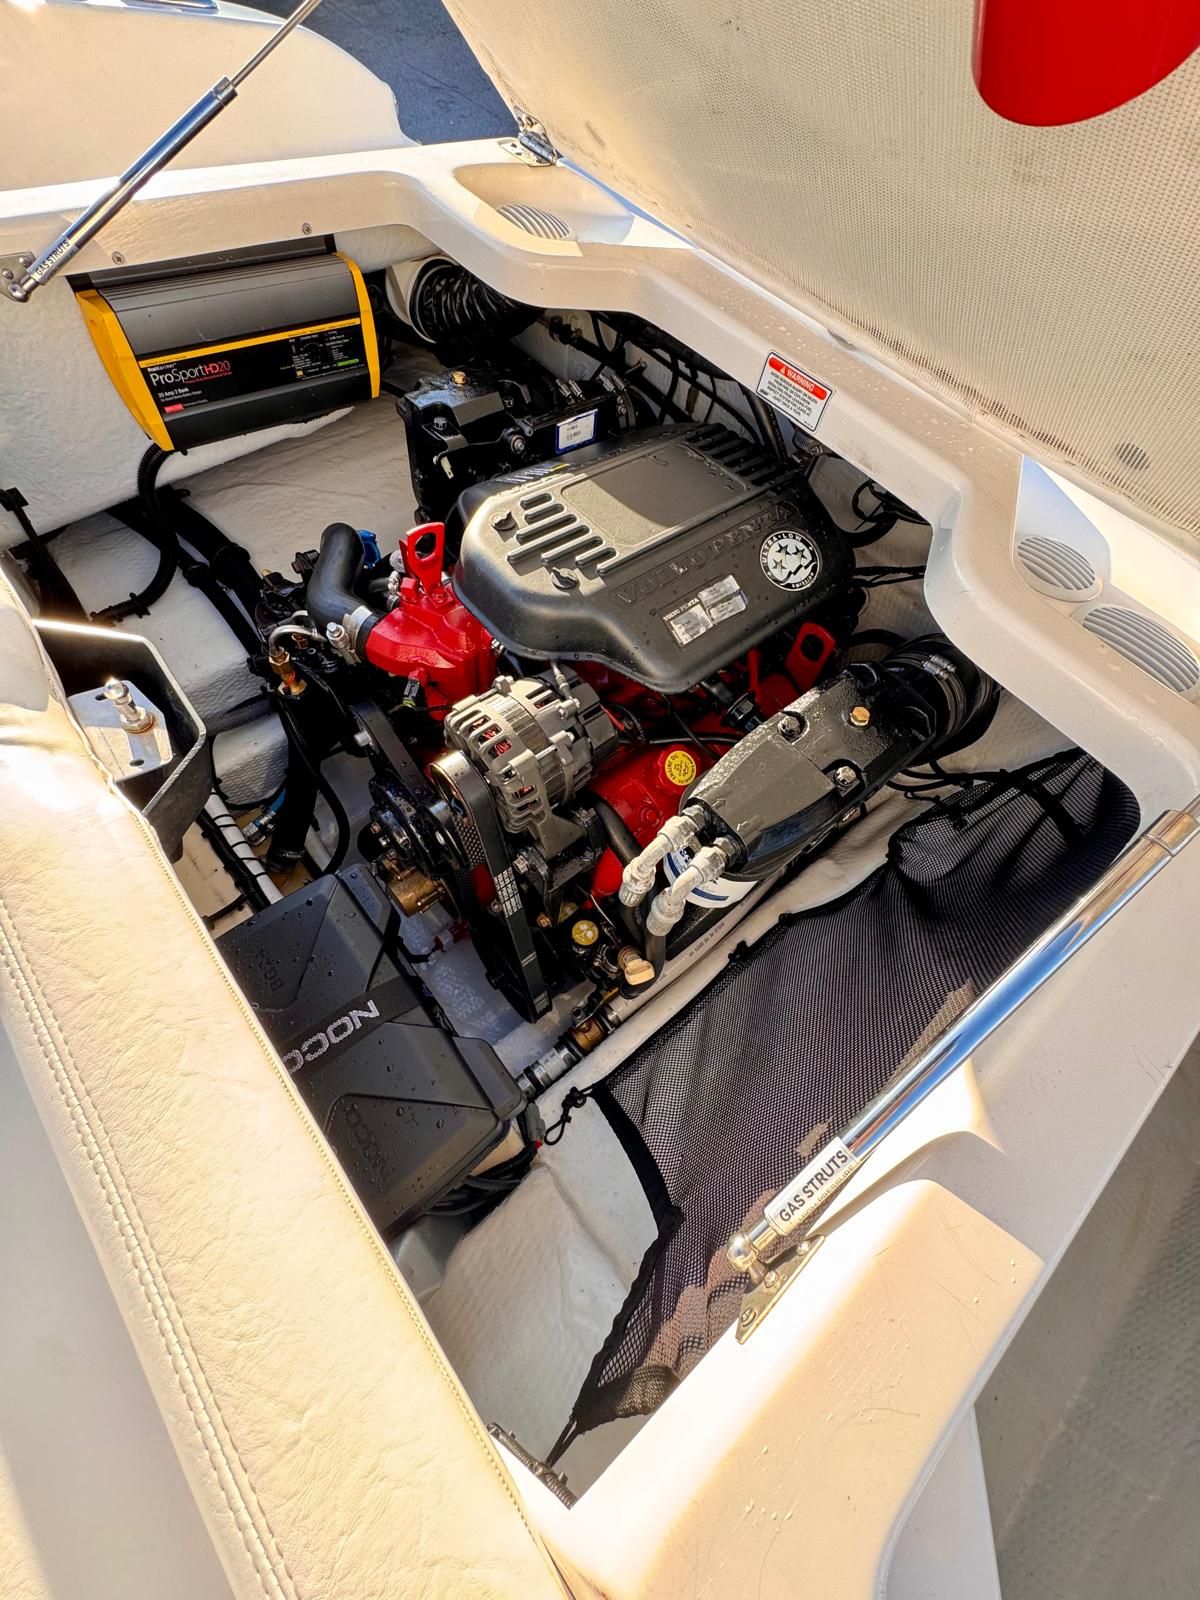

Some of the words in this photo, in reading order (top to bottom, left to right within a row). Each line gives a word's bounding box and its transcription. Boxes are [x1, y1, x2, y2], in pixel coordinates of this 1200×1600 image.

[36, 261, 50, 276] GAS
[46, 239, 70, 265] STRUTS
[786, 370, 815, 390] WARNING
[663, 609, 680, 621] VOLVO
[780, 1194, 805, 1221] GAS
[803, 1150, 848, 1198] STRUTS
